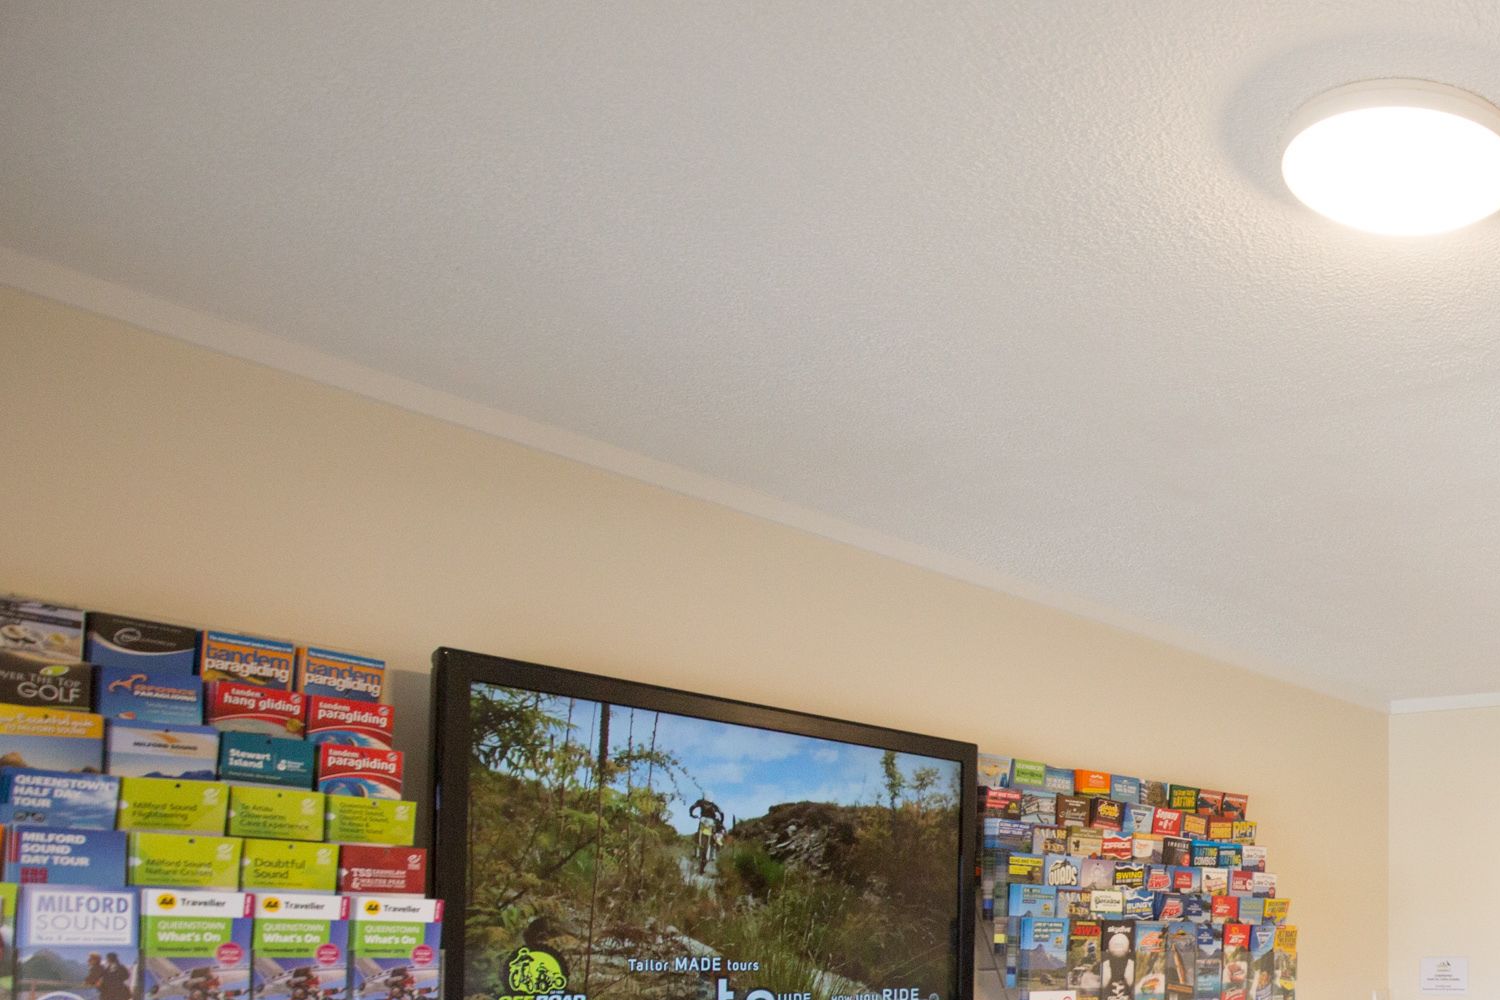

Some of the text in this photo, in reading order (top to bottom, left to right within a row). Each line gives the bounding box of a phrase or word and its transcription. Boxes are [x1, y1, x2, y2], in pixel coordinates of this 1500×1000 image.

[207, 645, 290, 669] tandem
[0, 670, 24, 682] VER
[205, 657, 290, 683] paragliding
[306, 660, 382, 684] tandem
[305, 672, 382, 697] paragliding
[17, 681, 81, 703] GOLF
[223, 693, 301, 715] hang gliding
[317, 710, 388, 727] paragliding
[228, 748, 271, 761] Stewart
[327, 756, 397, 773] paragliding
[13, 786, 81, 799] HALF DAY
[13, 797, 52, 808] TOUR
[23, 832, 86, 845] MILFORD
[23, 845, 72, 856] SOUND
[21, 855, 90, 867] DAY TOUR
[254, 858, 306, 869] Doubtful
[254, 869, 290, 879] Sound
[36, 895, 129, 914] MILFORD
[181, 898, 226, 908] Traveller
[284, 902, 325, 911] Traveller
[383, 905, 421, 913] Traveller
[35, 914, 128, 931] SOUND
[157, 931, 221, 943] What's On
[263, 933, 320, 944] What's On
[364, 934, 416, 945] What's On
[628, 957, 759, 971] Tailor MADE tours
